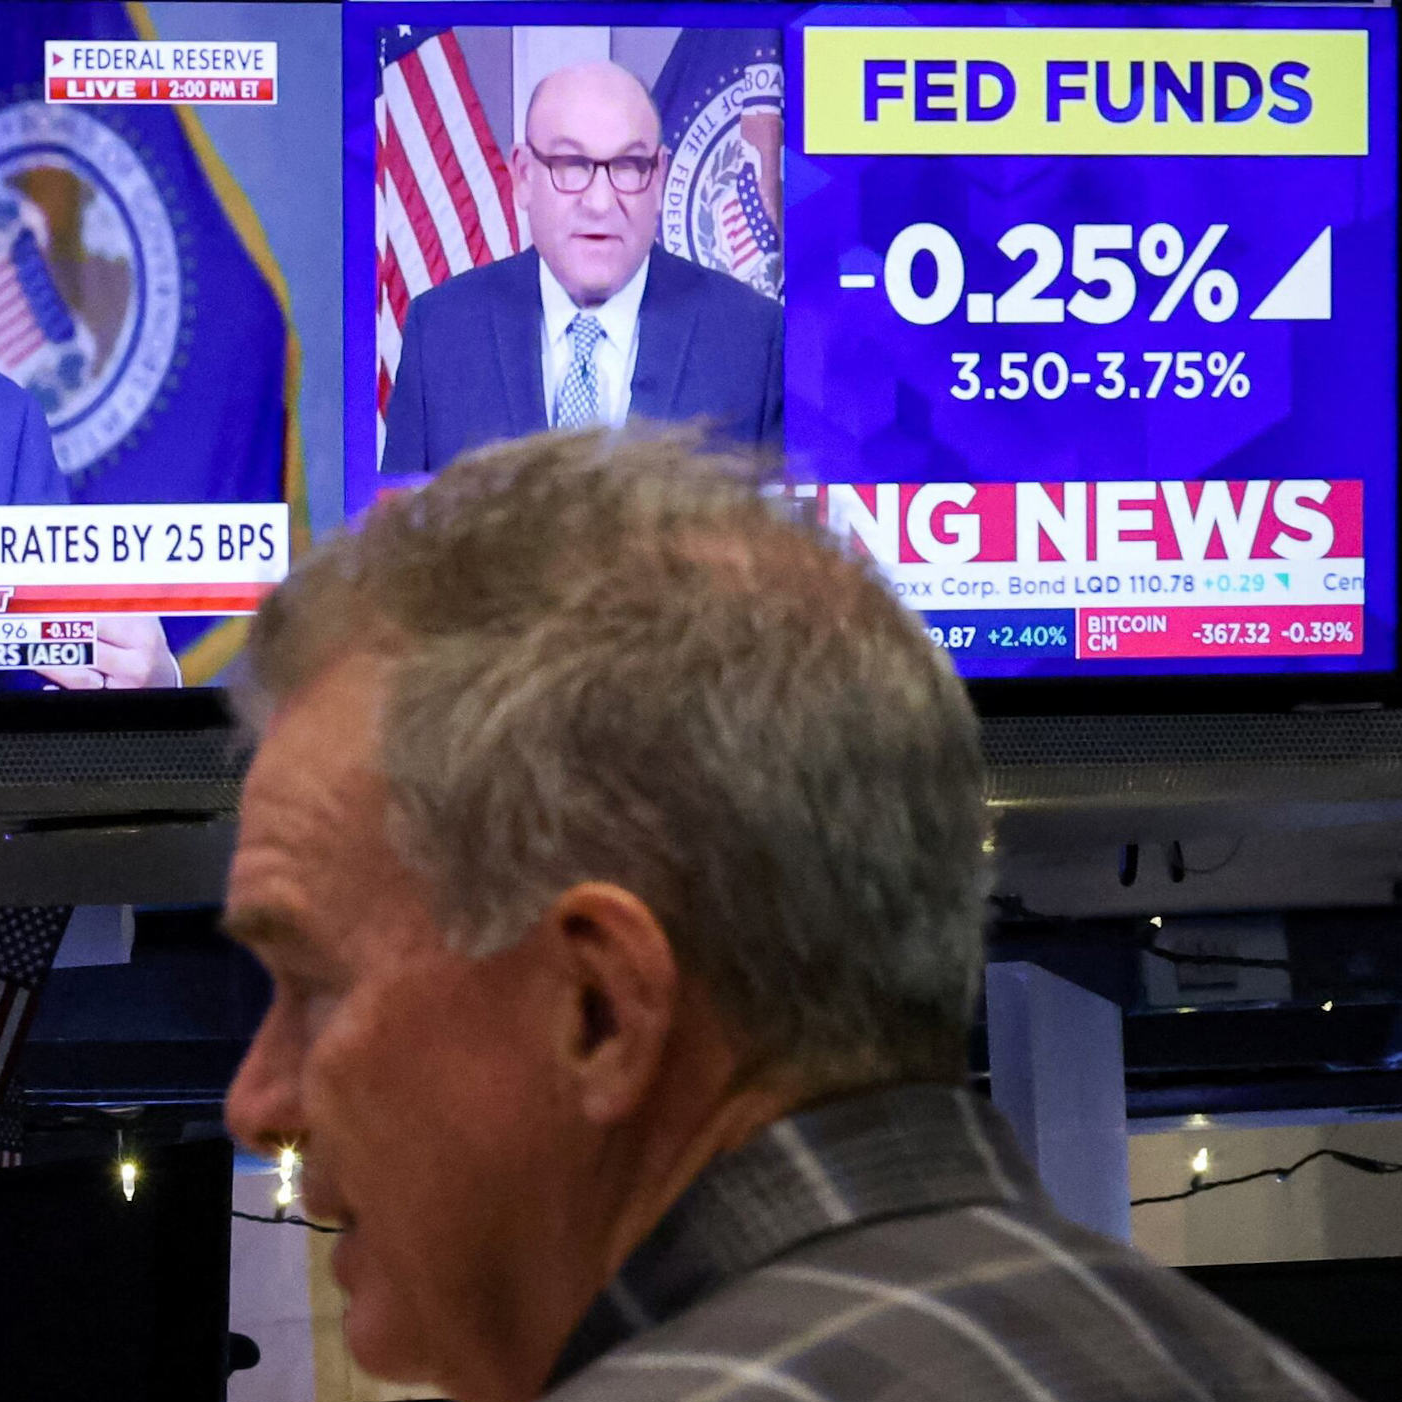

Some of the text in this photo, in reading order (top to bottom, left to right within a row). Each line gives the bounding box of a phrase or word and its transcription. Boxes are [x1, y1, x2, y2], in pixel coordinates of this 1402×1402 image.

[74, 48, 263, 71] FEDERAL RESERVE
[66, 80, 260, 98] LIVE 2:00 PM ET
[863, 60, 1313, 124] FED FUNDS
[666, 163, 690, 254] FEDERA
[839, 221, 1240, 325] -0.25%
[950, 351, 1251, 401] 3.50-3.75%
[1015, 480, 1335, 563] NEWS
[0, 525, 99, 564] RATES
[112, 524, 152, 562] BY
[165, 524, 205, 562] 25
[217, 522, 276, 561] BPS
[941, 577, 1000, 602] Corp.
[1009, 575, 1066, 595] Bond
[1075, 574, 1121, 595] LQD
[1129, 573, 1195, 594] 110.78
[1203, 573, 1265, 593] +0.29
[924, 625, 1068, 649] 9.87 +2.40%
[1087, 615, 1167, 634] BITCOIN
[1192, 620, 1355, 646] -367.32 -0.39%
[1087, 634, 1119, 653] CM
